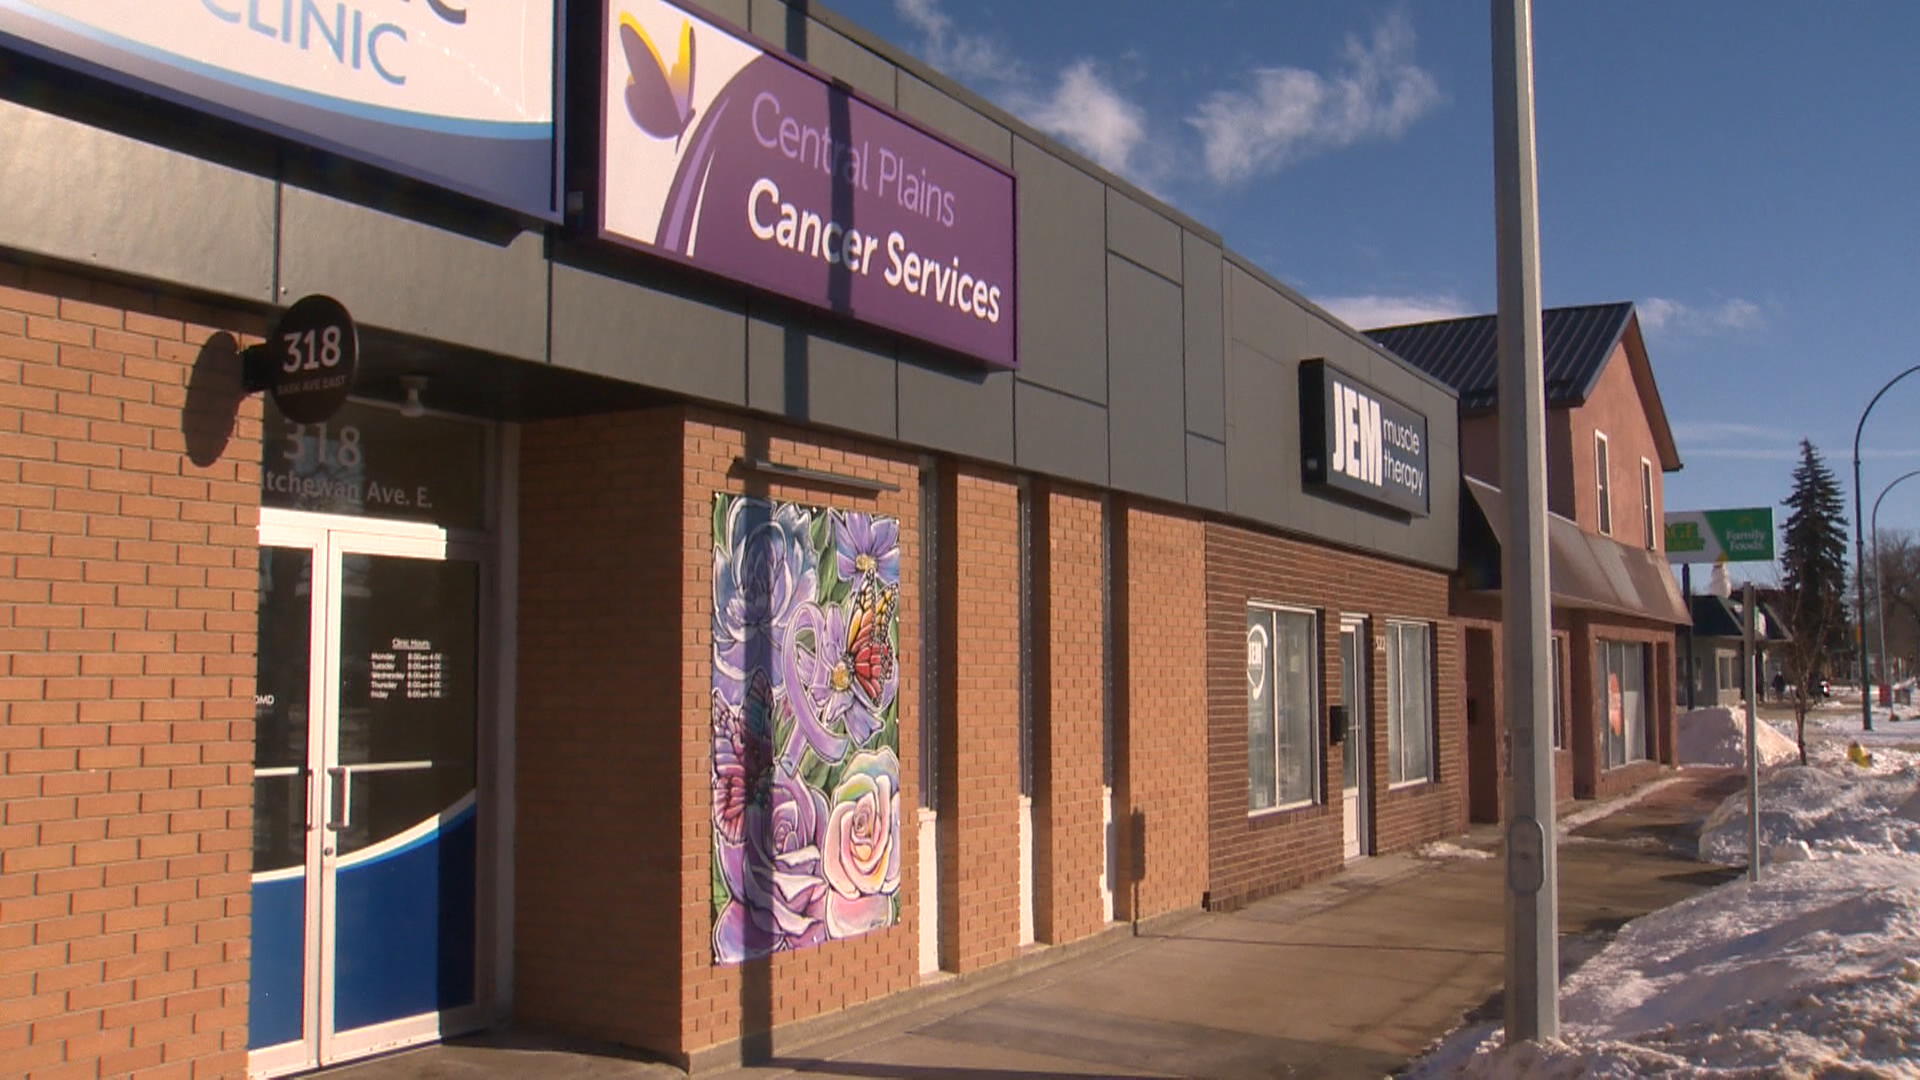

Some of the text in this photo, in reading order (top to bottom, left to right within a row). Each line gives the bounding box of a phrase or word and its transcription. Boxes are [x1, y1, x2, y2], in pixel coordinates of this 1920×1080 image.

[752, 91, 955, 228] Central Plains
[748, 178, 1000, 323] Cancer Services
[283, 325, 342, 373] 318
[282, 418, 361, 467] 318
[1333, 381, 1383, 487] JEM
[1384, 418, 1420, 455] muscle
[263, 471, 432, 508] tchewan Ave. E.
[1384, 451, 1424, 496] therapy
[1726, 529, 1765, 542] Family
